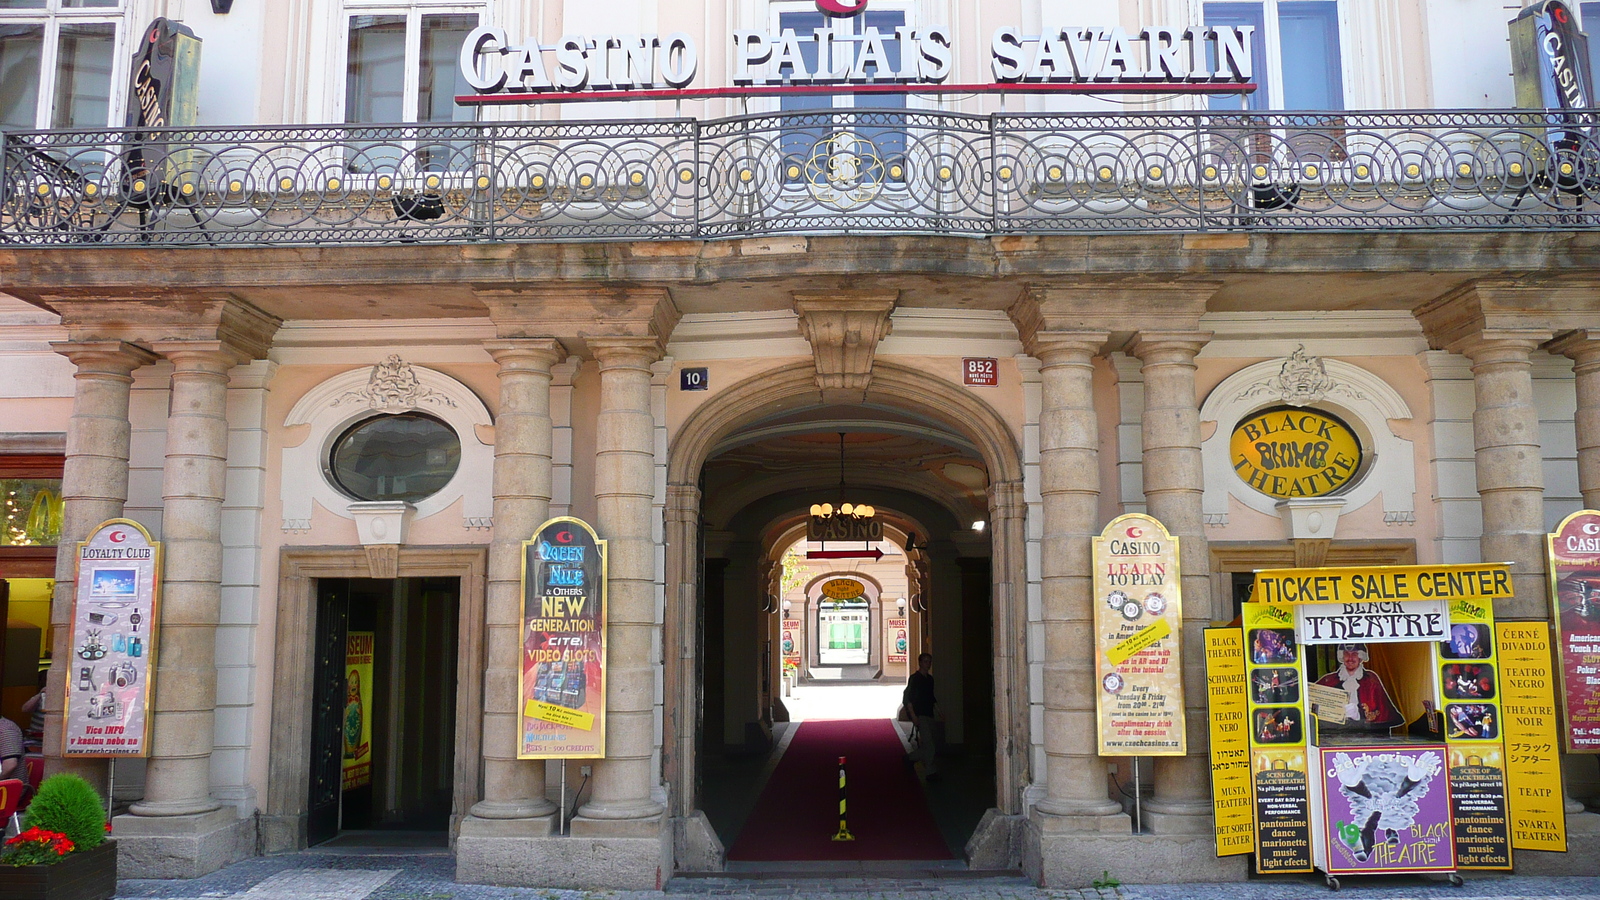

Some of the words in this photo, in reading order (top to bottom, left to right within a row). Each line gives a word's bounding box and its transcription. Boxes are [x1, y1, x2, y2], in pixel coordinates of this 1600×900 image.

[460, 25, 697, 93] CASINO
[733, 24, 952, 85] PALAIS
[990, 25, 1255, 83] SAVARIN
[969, 361, 992, 372] 852
[686, 373, 700, 385] 10
[1242, 414, 1338, 443] BLACK
[1234, 452, 1355, 496] THEATRE
[811, 519, 880, 538] CASINO
[539, 541, 586, 560] QUEEN
[1110, 540, 1160, 554] CASINO
[83, 548, 124, 558] LOYALTY
[127, 548, 150, 558] CLUB
[1108, 563, 1166, 575] LEARN
[547, 565, 584, 586] NILE
[1108, 574, 1128, 586] TO
[1132, 574, 1165, 585] PLAY
[553, 587, 582, 595] OTHERS
[1261, 576, 1341, 603] TICKET
[1352, 574, 1409, 599] SALE
[1417, 570, 1510, 597] CENTER
[542, 597, 586, 617] NEW
[1343, 601, 1404, 614] BLACK
[530, 619, 594, 631] GENERATION
[1306, 613, 1442, 639] THEATRE
[1503, 629, 1539, 639] ČERNÉ
[1212, 638, 1236, 646] BLACK
[1502, 642, 1545, 650] DIVADLO
[528, 650, 560, 662] VIDEO
[563, 650, 595, 662] SLOTS
[1207, 649, 1241, 658] THEATRE
[1505, 668, 1545, 676] TEATRO
[1577, 666, 1597, 674] Poker
[1208, 674, 1244, 684] SCHWARZE
[1510, 680, 1544, 688] NEGRO
[1211, 686, 1244, 695] THEATRE
[1505, 706, 1552, 715] THEATRE
[1215, 712, 1242, 721] TEATRO
[527, 722, 538, 731] BIG
[1517, 718, 1543, 726] NOIR
[105, 726, 124, 734] INFO
[1219, 723, 1238, 732] NERO
[77, 737, 104, 745] kasinu
[106, 737, 125, 745] nebo
[526, 744, 542, 752] BETS
[1511, 743, 1551, 752] ブラック
[1510, 755, 1550, 764] シアター
[1328, 753, 1372, 778] czech
[1222, 787, 1246, 796] MUSTA
[1216, 797, 1250, 808] TEATTERI
[1261, 820, 1306, 829] pantomime
[1454, 816, 1504, 825] pantomime
[1519, 820, 1556, 830] SVARTA
[1217, 826, 1230, 835] DET
[1232, 823, 1253, 833] SORTE
[1336, 820, 1359, 844] 19
[1410, 822, 1449, 838] BLACK
[1222, 835, 1250, 846] TEATER
[1457, 835, 1504, 843] marionette
[1515, 831, 1560, 841] TEATERN
[1262, 839, 1306, 847] marionette
[1332, 837, 1357, 867] tradition
[1372, 841, 1437, 867] THEATRE
[1264, 859, 1282, 868] light
[1458, 855, 1478, 864] light
